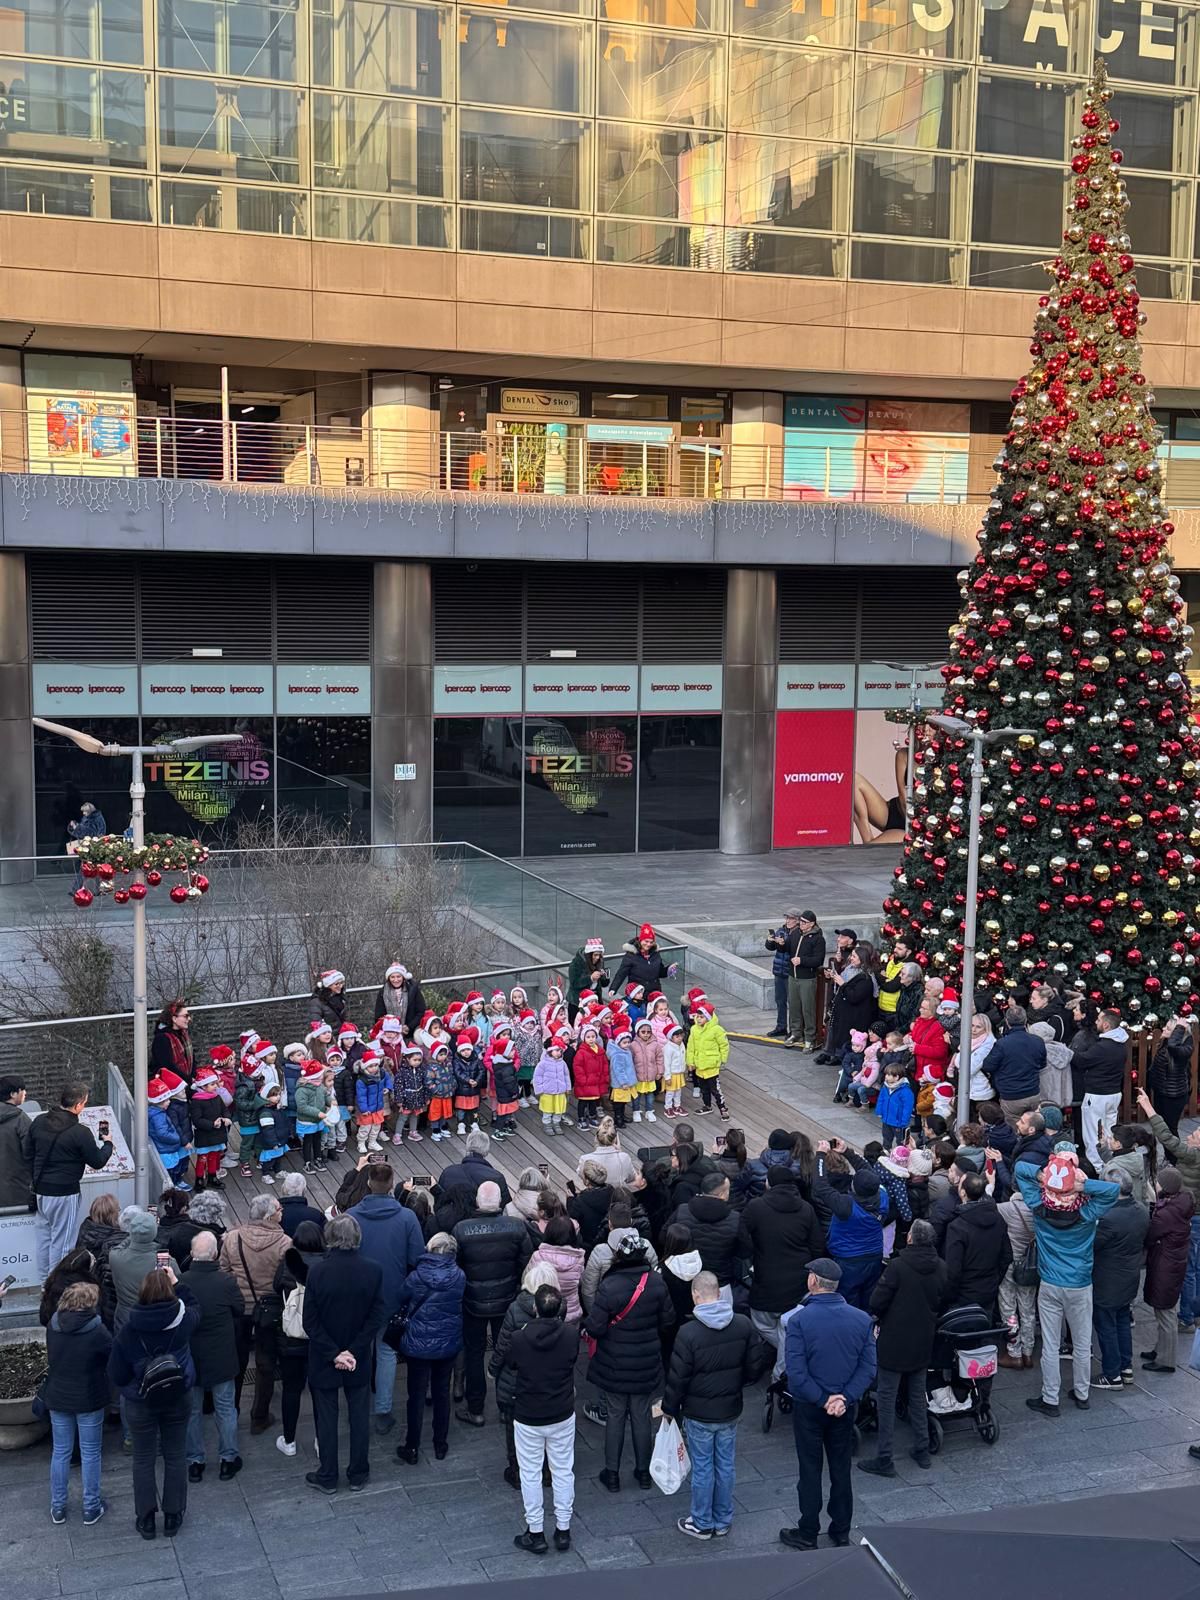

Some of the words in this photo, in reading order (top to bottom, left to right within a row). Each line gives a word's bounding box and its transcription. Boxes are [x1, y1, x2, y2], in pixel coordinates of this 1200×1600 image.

[506, 396, 535, 404] DENTAL
[791, 408, 837, 417] DENTAL
[868, 411, 913, 419] BEAUTY
[46, 683, 83, 695] ipercoop
[88, 683, 125, 695] ipercoop
[150, 683, 186, 695] ipercoop
[190, 684, 225, 695] ipercoop
[229, 684, 264, 694] ipercoop
[288, 684, 321, 694] ipercoop
[326, 684, 359, 694] ipercoop
[444, 684, 476, 694] ipercoop
[480, 684, 511, 693] ipercoop
[533, 683, 563, 693] ipercoop
[567, 683, 598, 692] ipercoop
[601, 683, 631, 692] ipercoop
[651, 683, 680, 692] ipercoop
[684, 682, 712, 691] ipercoop
[786, 682, 814, 691] ipercoop
[818, 682, 845, 690] ipercoop
[865, 681, 891, 690] ipercoop
[895, 681, 921, 690] ipercp
[784, 773, 844, 785] yamamay
[553, 782, 580, 791] Milan
[178, 790, 208, 801] Milan
[571, 795, 597, 805] London
[199, 803, 228, 815] London
[2, 1252, 33, 1264] sola.
